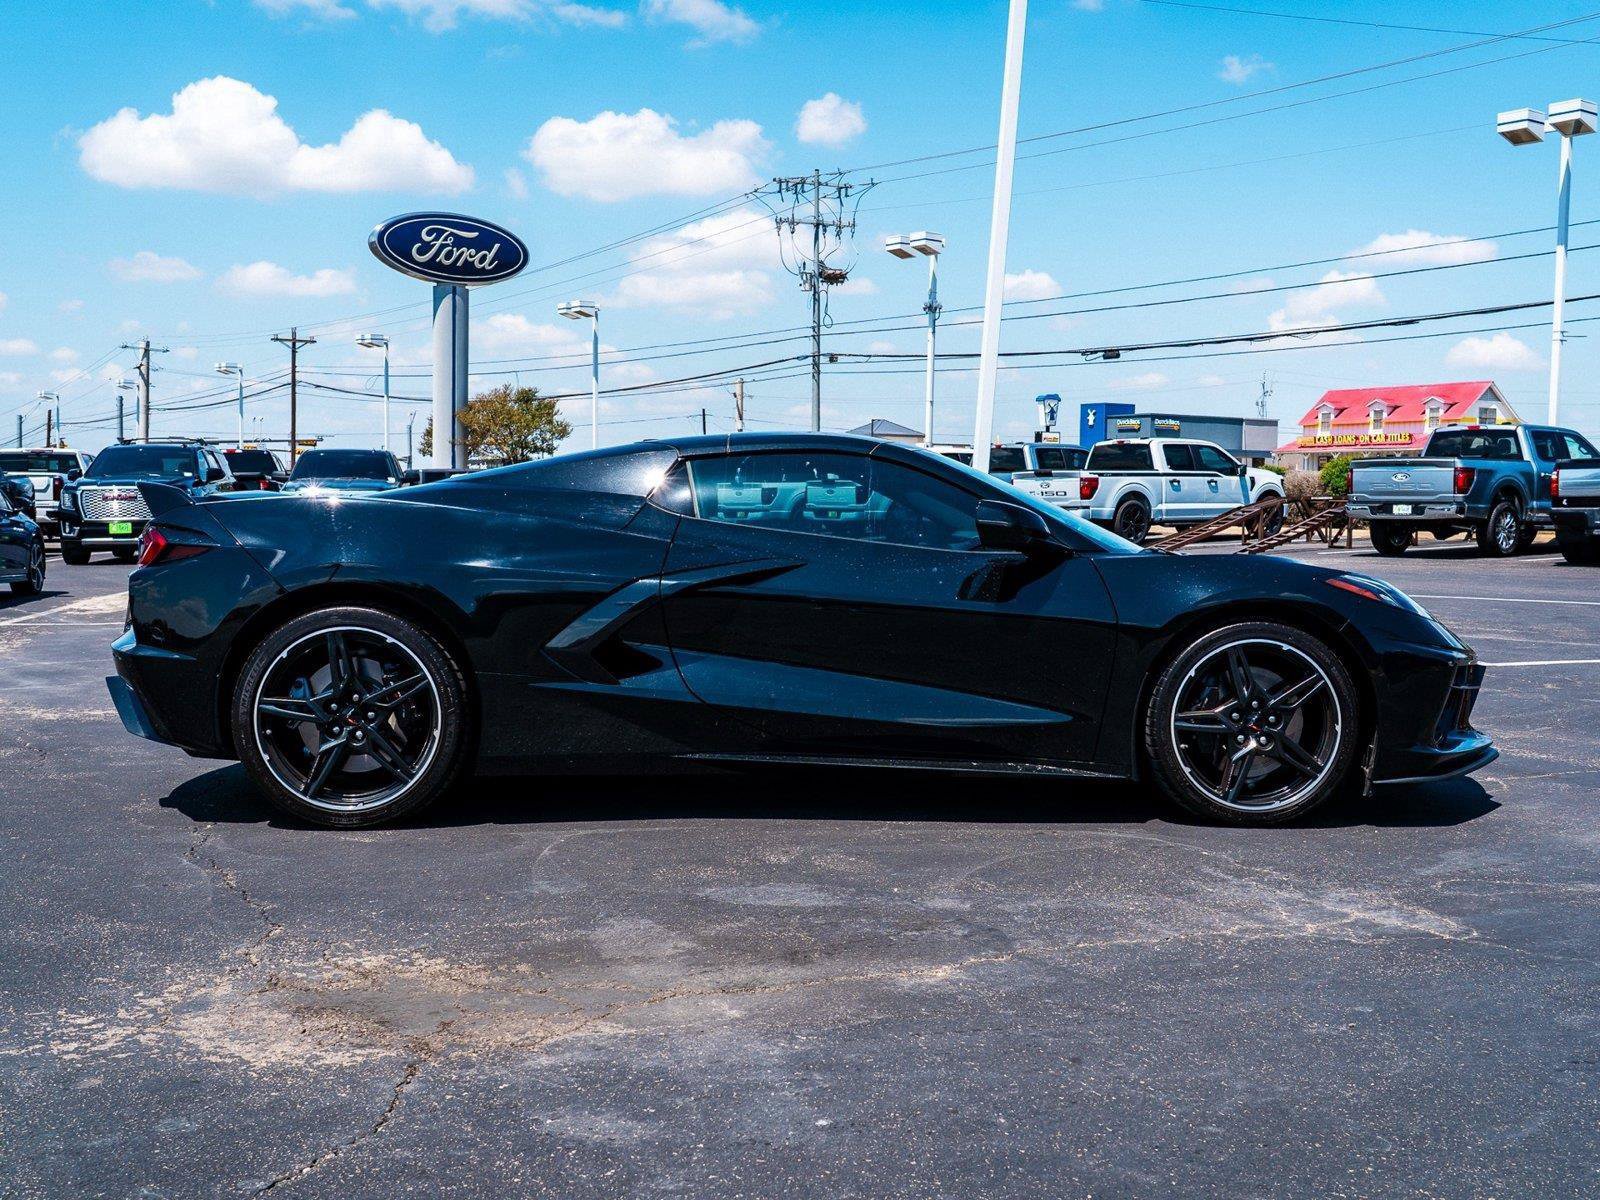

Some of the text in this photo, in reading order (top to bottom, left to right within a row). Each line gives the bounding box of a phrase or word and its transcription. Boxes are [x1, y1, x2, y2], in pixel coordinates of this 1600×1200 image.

[411, 225, 501, 270] Ford
[1335, 434, 1355, 444] LOANS
[1359, 434, 1369, 443] ON
[1371, 433, 1385, 443] CAR
[1387, 432, 1411, 442] TITLES
